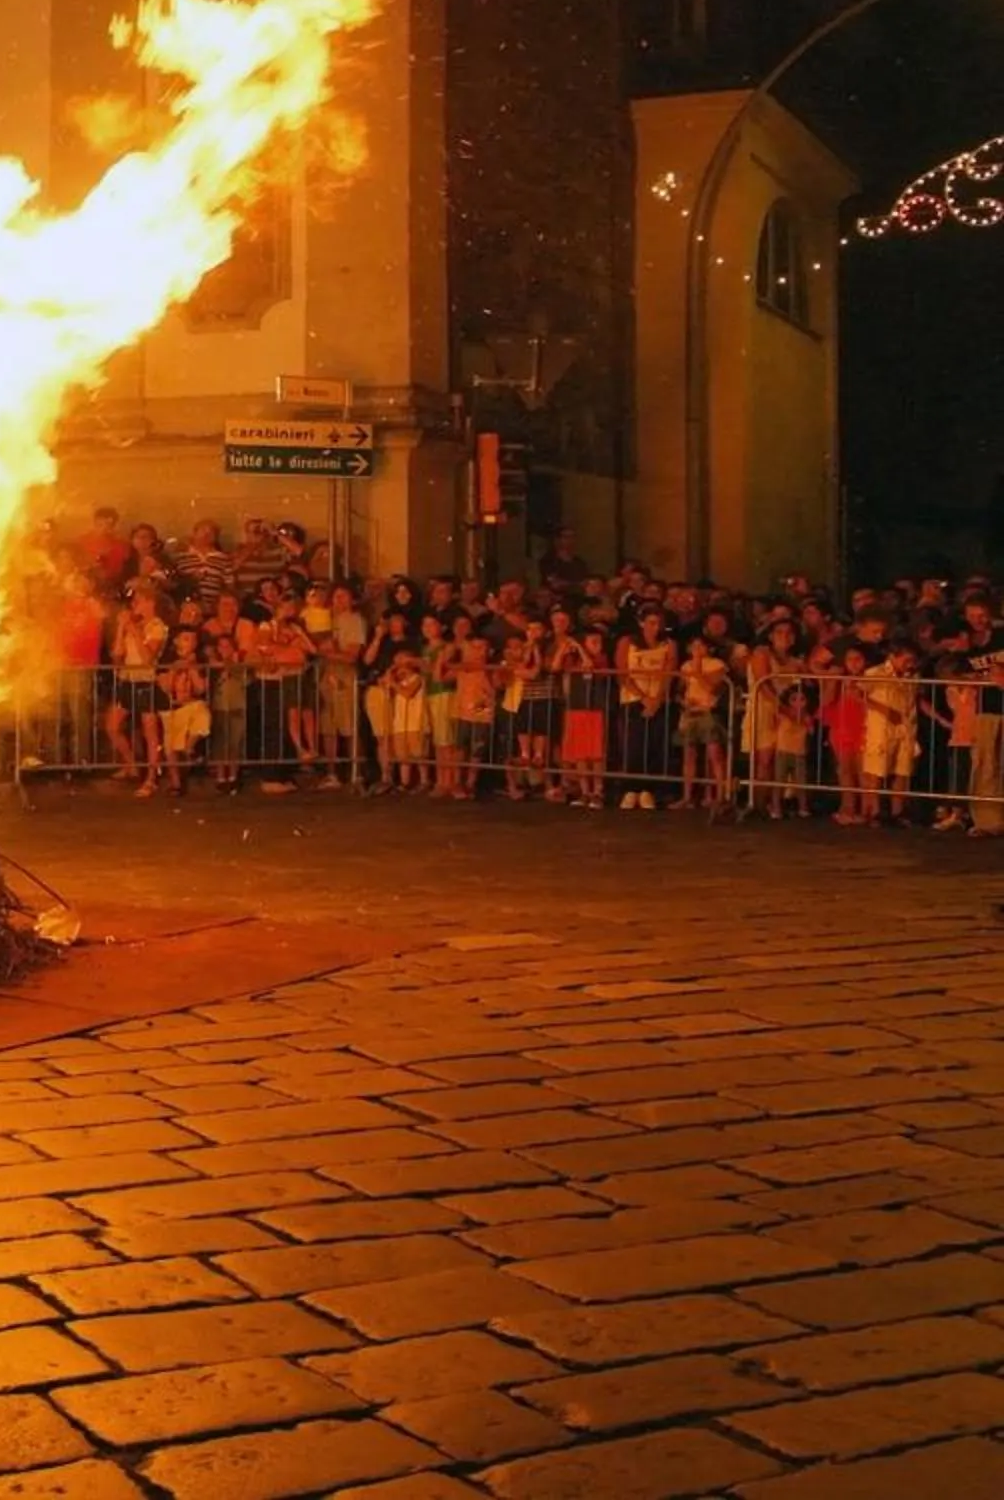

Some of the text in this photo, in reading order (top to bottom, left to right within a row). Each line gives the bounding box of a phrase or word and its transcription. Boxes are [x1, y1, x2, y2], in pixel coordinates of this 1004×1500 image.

[229, 426, 316, 442] carabinieri
[230, 453, 342, 470] tutte le direzioni
